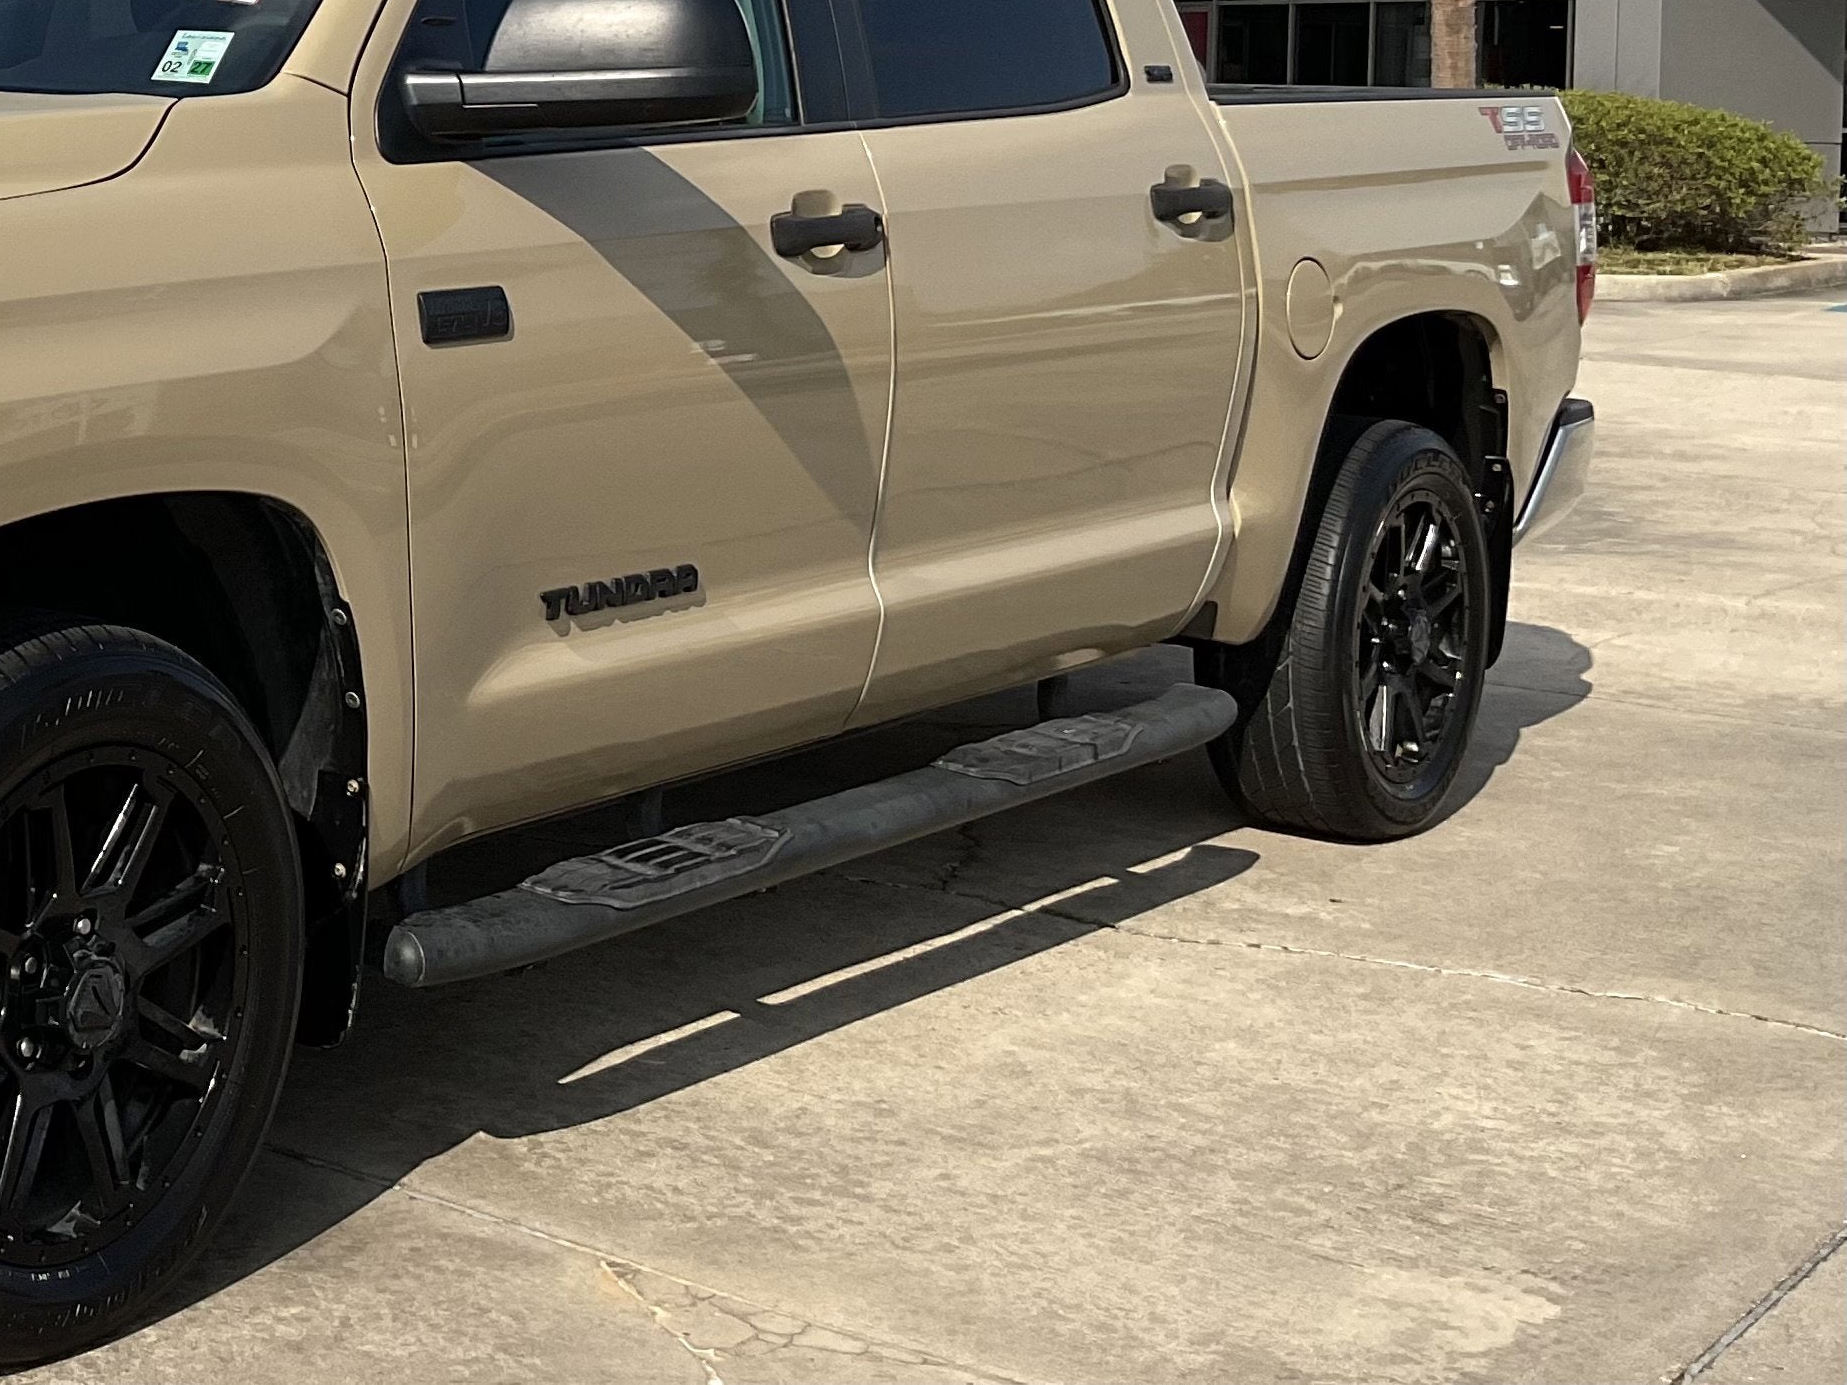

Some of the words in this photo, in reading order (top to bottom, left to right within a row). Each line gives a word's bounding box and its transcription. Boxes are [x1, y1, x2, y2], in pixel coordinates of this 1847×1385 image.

[161, 60, 183, 73] 02
[190, 61, 211, 74] 27
[539, 563, 699, 621] TUNDRA
